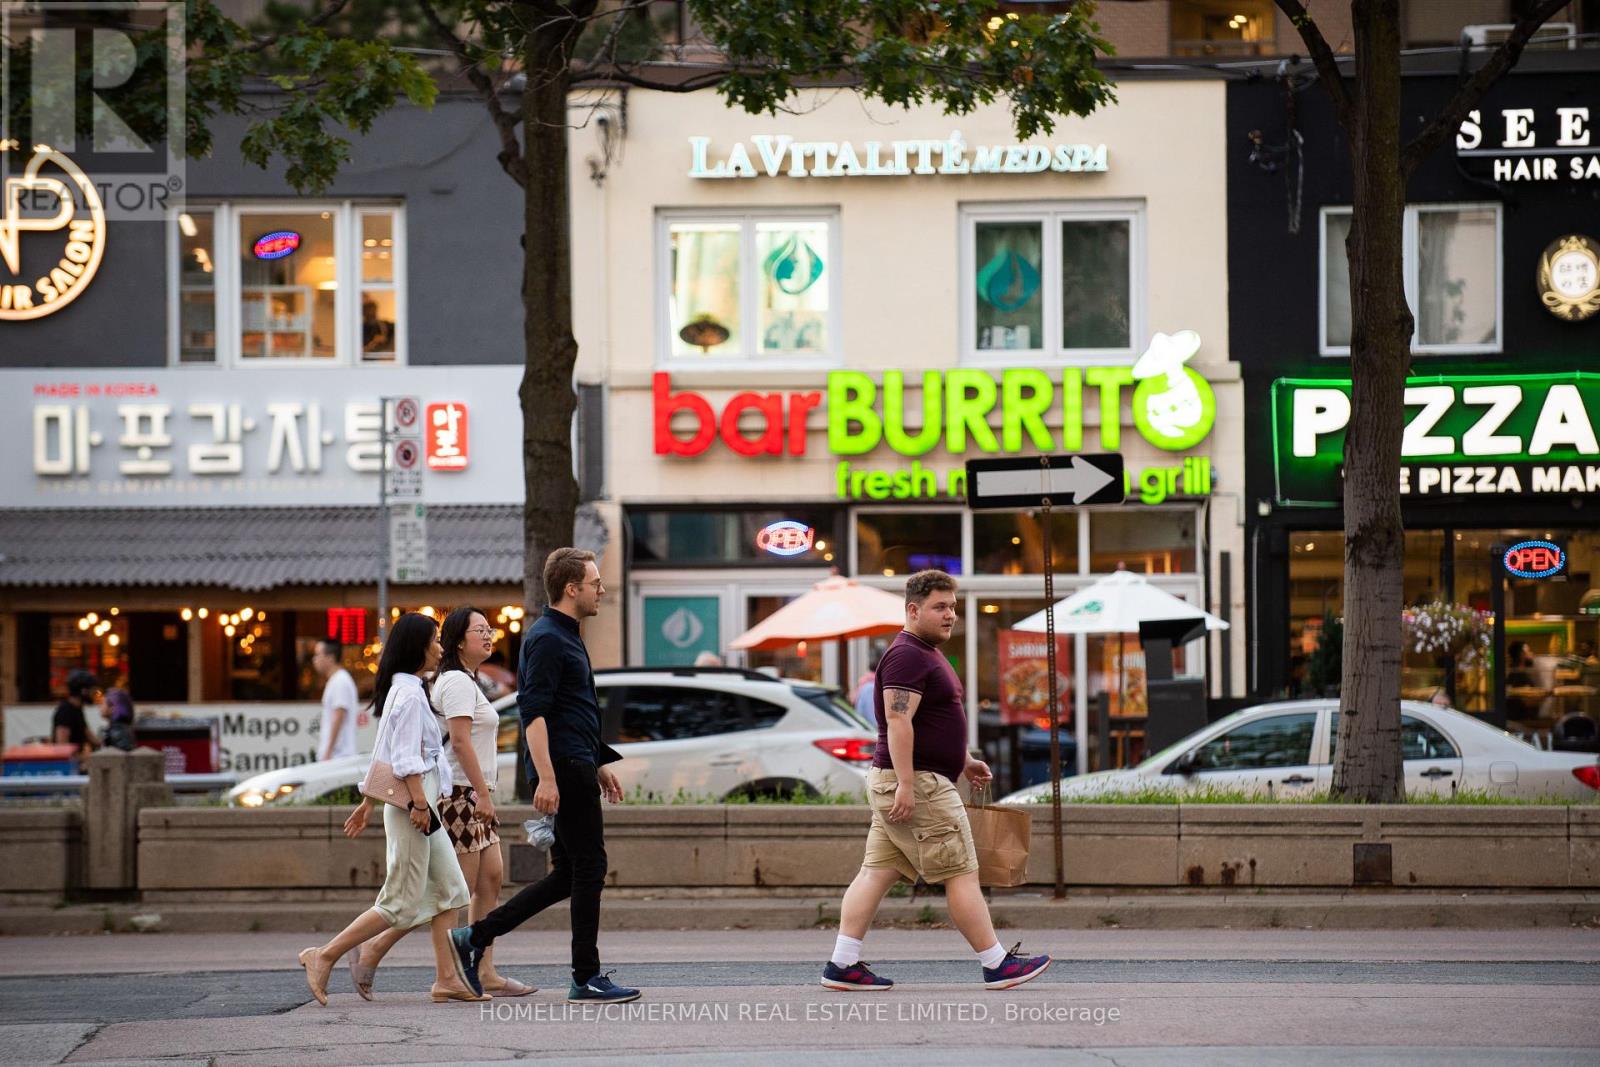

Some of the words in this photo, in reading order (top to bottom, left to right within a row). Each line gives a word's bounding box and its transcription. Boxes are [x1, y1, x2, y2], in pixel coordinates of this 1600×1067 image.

[971, 144, 1050, 174] MED
[1050, 143, 1109, 172] SPA
[1494, 157, 1558, 181] HAIR
[35, 219, 95, 304] SALON
[1293, 385, 1600, 457] PZZA
[836, 460, 937, 499] fresh
[1139, 456, 1212, 503] grill
[1419, 466, 1522, 494] PIZZA
[756, 527, 815, 550] OPEN
[1507, 547, 1560, 571] OPEN
[222, 713, 300, 741] Mapo
